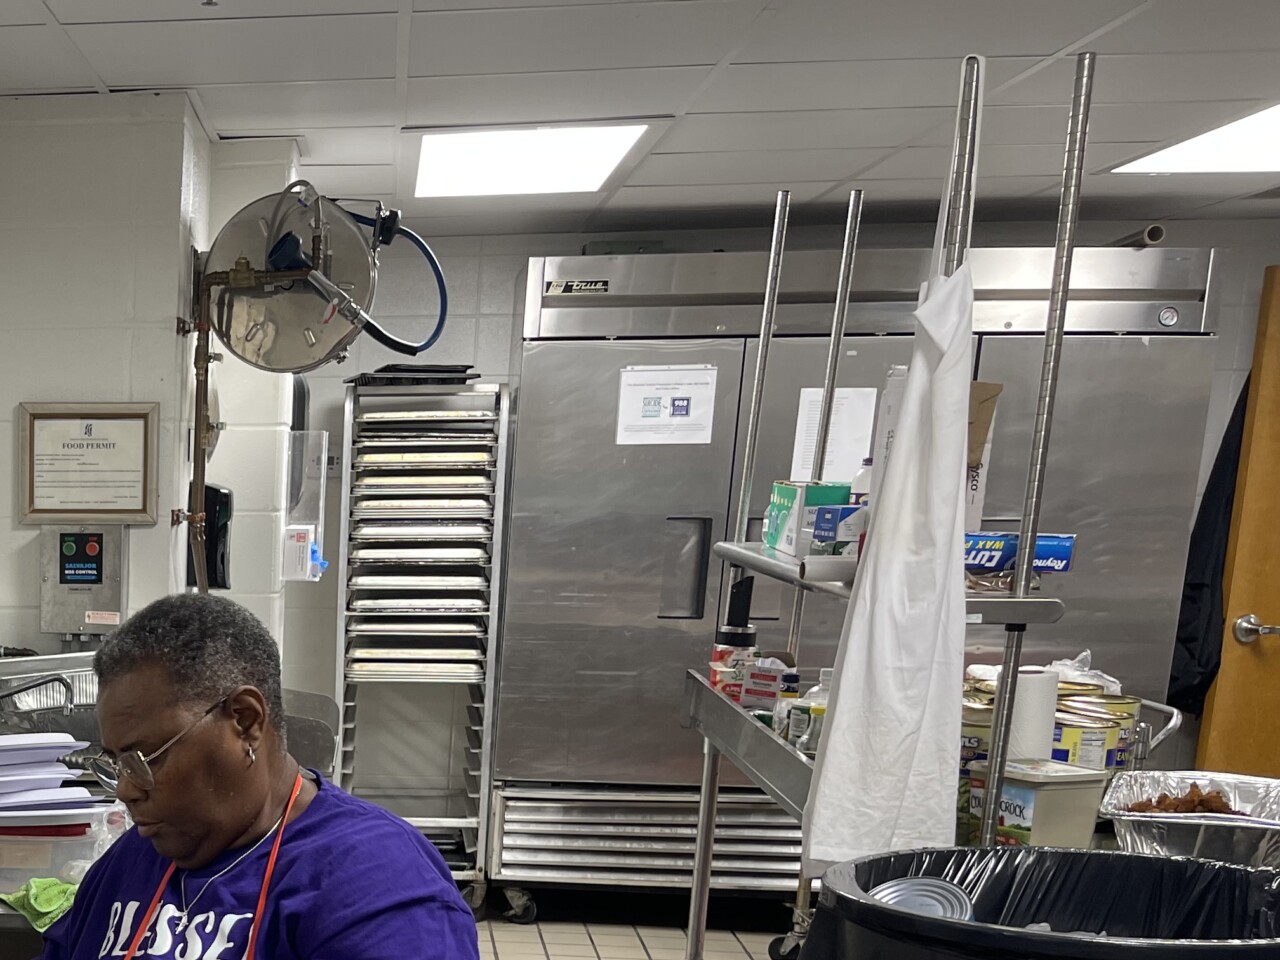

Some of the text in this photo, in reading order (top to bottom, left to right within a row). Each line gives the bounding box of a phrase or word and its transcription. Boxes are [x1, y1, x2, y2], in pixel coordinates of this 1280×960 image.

[975, 540, 1005, 549] WAX
[1033, 557, 1067, 570] Reyno
[999, 800, 1026, 820] CROCK
